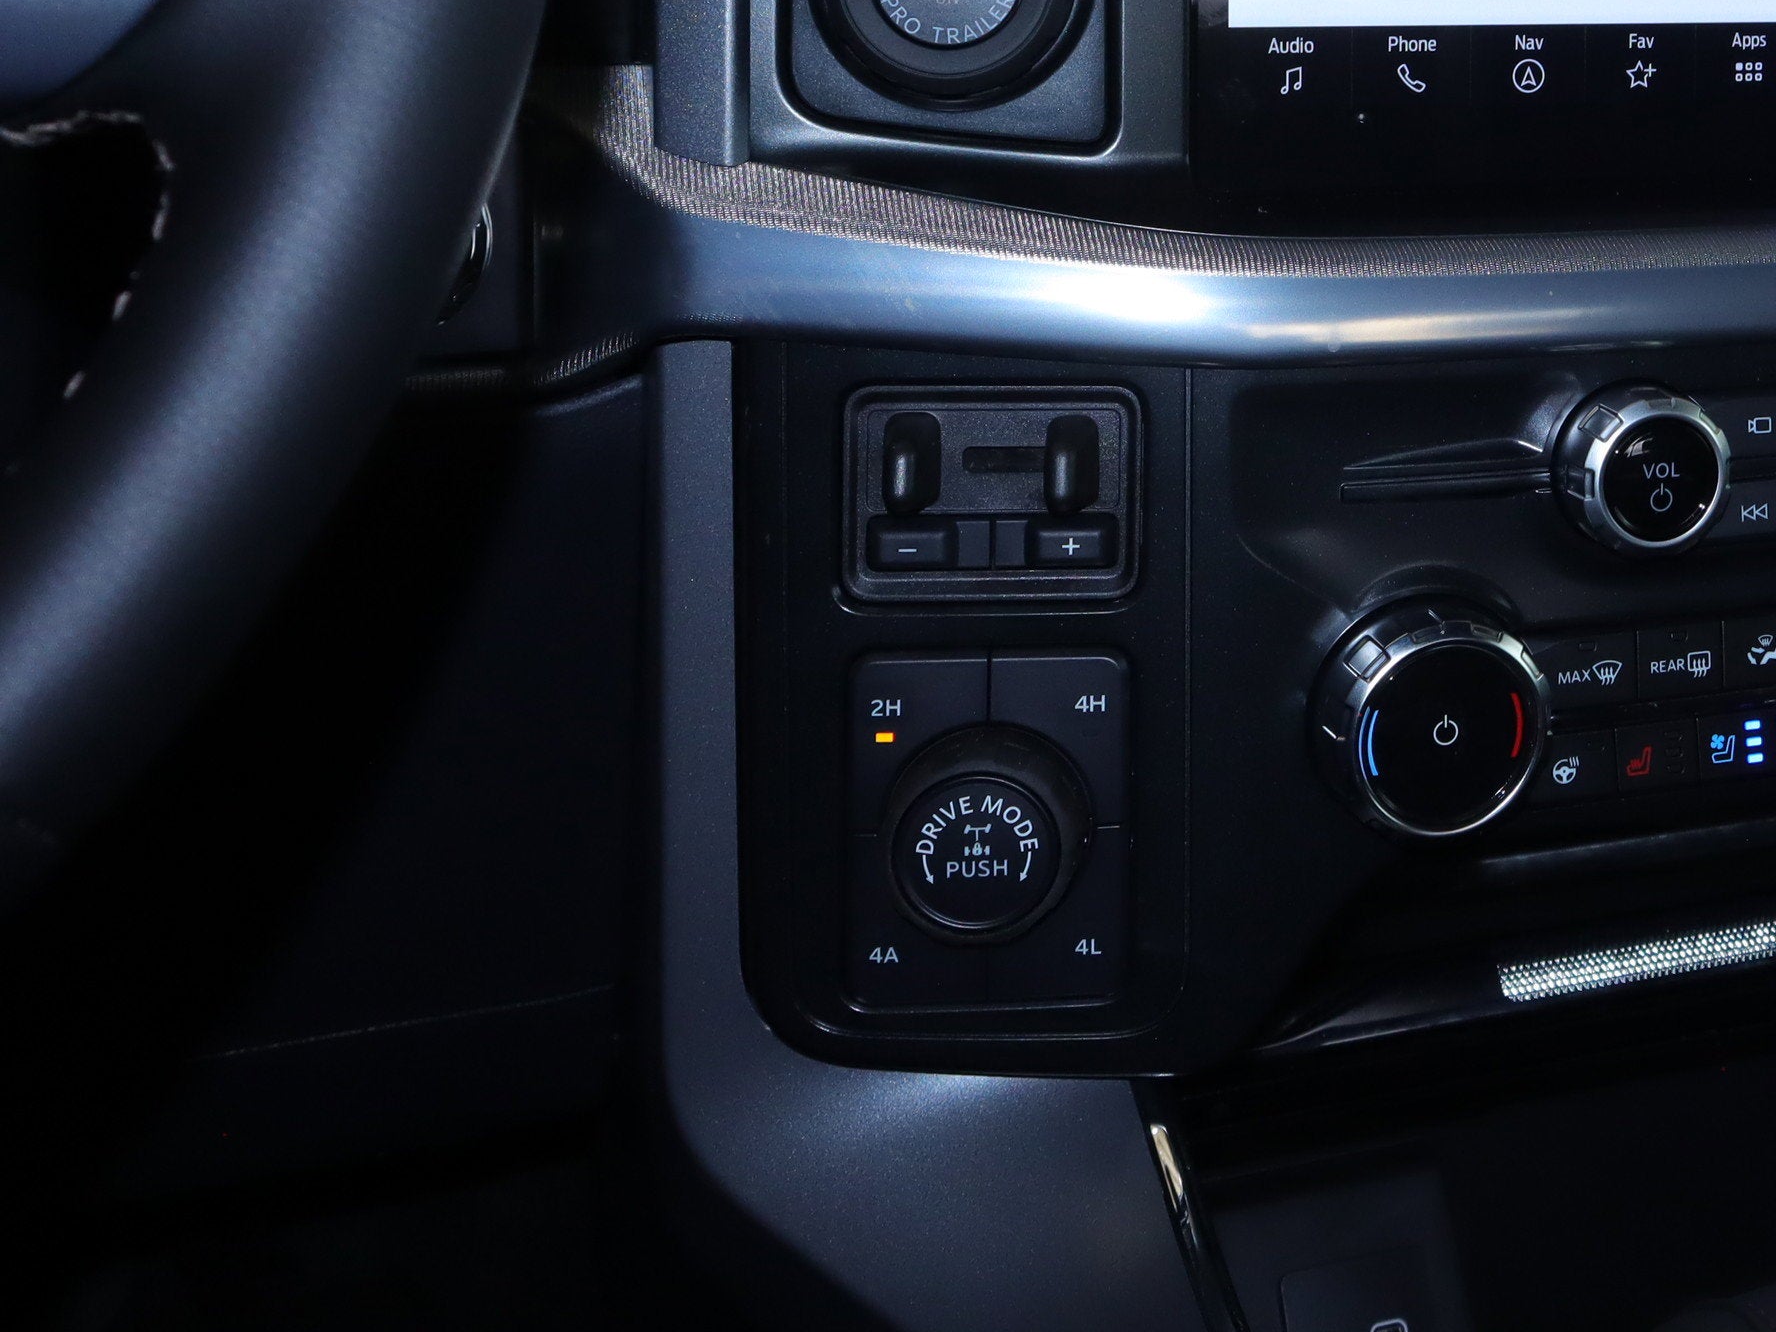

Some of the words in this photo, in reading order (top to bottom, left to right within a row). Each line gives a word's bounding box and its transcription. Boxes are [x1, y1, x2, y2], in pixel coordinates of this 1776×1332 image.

[1268, 35, 1315, 54] Audio
[1387, 35, 1437, 53] Phone
[1514, 34, 1544, 51] Nav
[1628, 33, 1655, 50] Fav
[1731, 32, 1768, 52] Apps
[1642, 462, 1680, 479] VOL
[1649, 657, 1685, 674] REAR
[1557, 668, 1591, 686] MAX
[870, 699, 902, 717] 2H
[1074, 694, 1107, 713] 4H
[915, 795, 973, 856] DRIVE
[981, 794, 1039, 852] MODE
[946, 859, 1009, 879] PUSH
[869, 947, 900, 964] 4A
[1074, 939, 1102, 956] 4L
